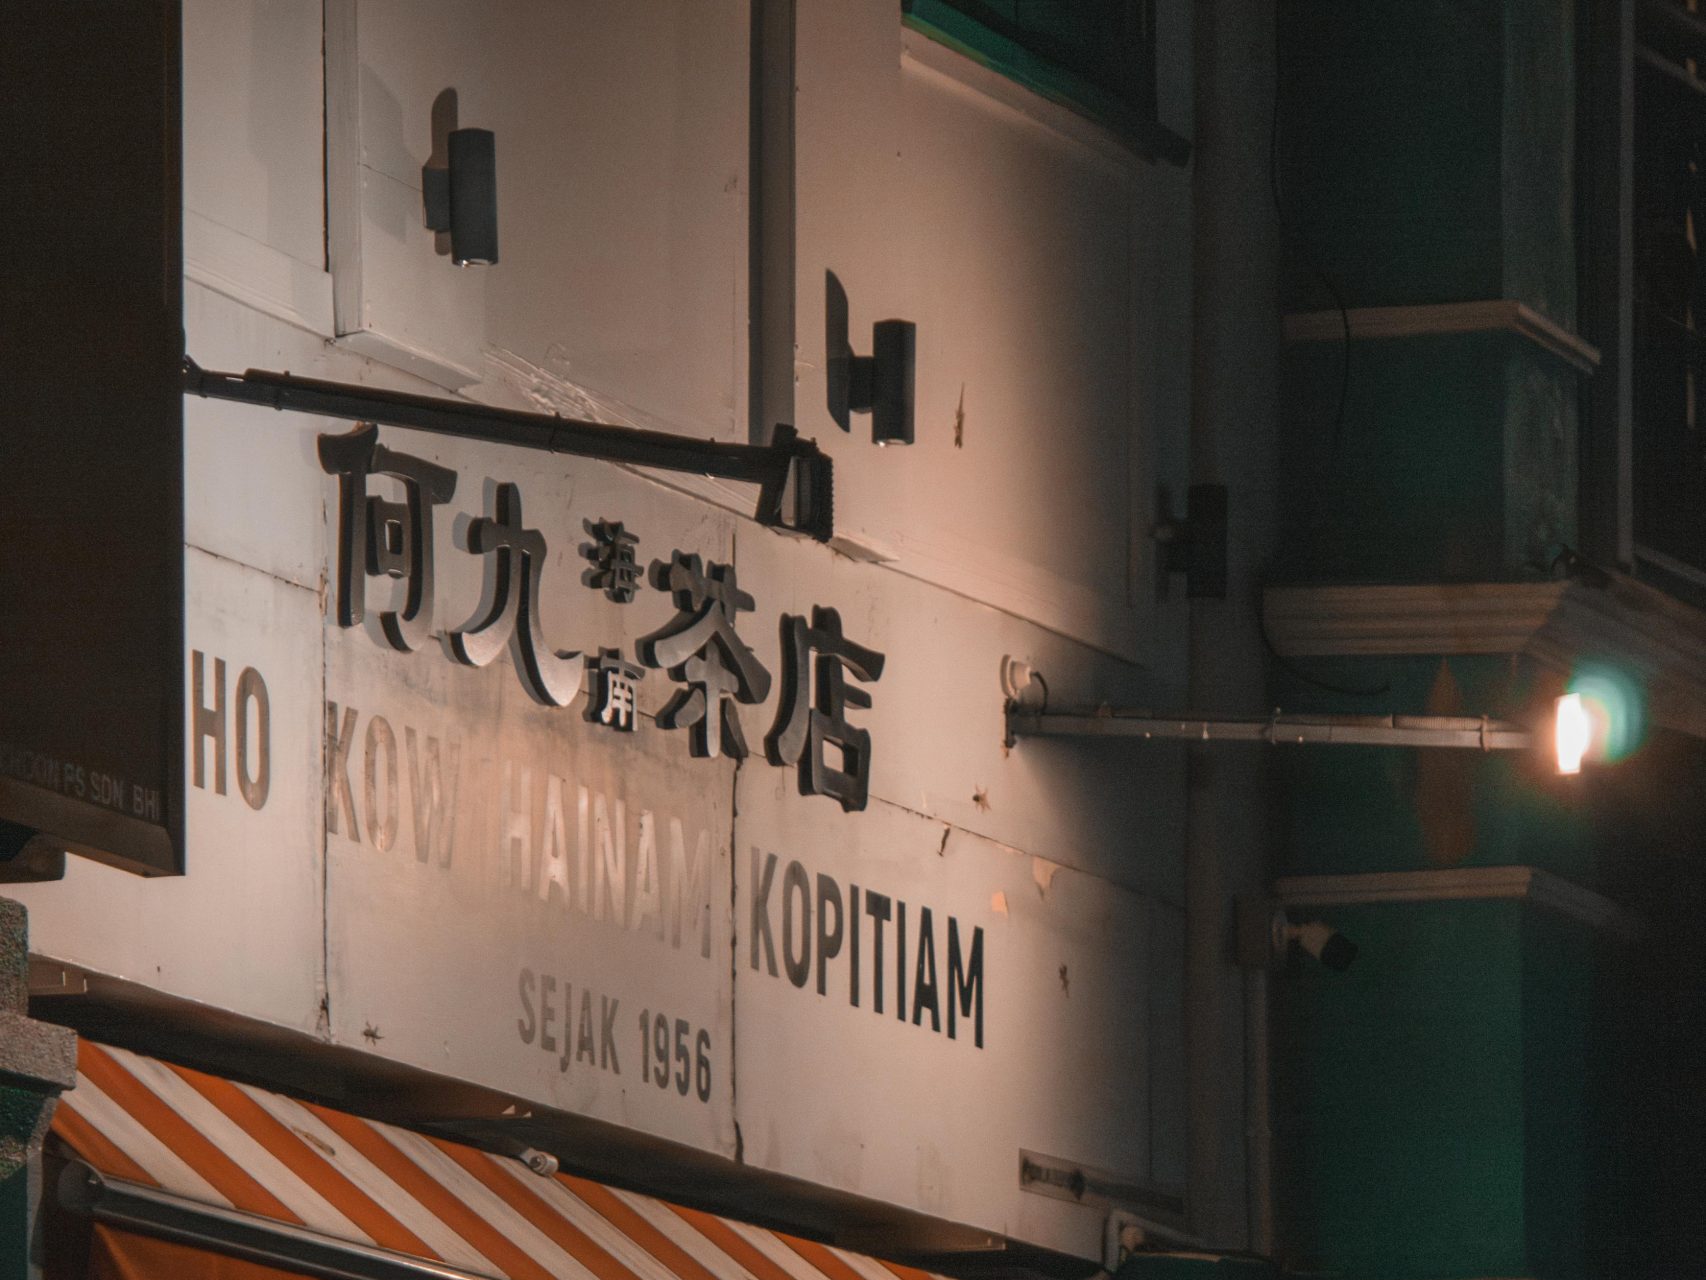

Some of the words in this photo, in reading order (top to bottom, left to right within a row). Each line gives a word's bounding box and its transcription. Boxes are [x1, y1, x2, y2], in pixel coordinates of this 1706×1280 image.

[192, 649, 270, 811] HO
[327, 700, 462, 870] KOW
[501, 758, 712, 960] HAINAM
[750, 846, 984, 1050] KOPITIAM
[517, 967, 621, 1075] SEJAK
[639, 1008, 712, 1104] 1956
